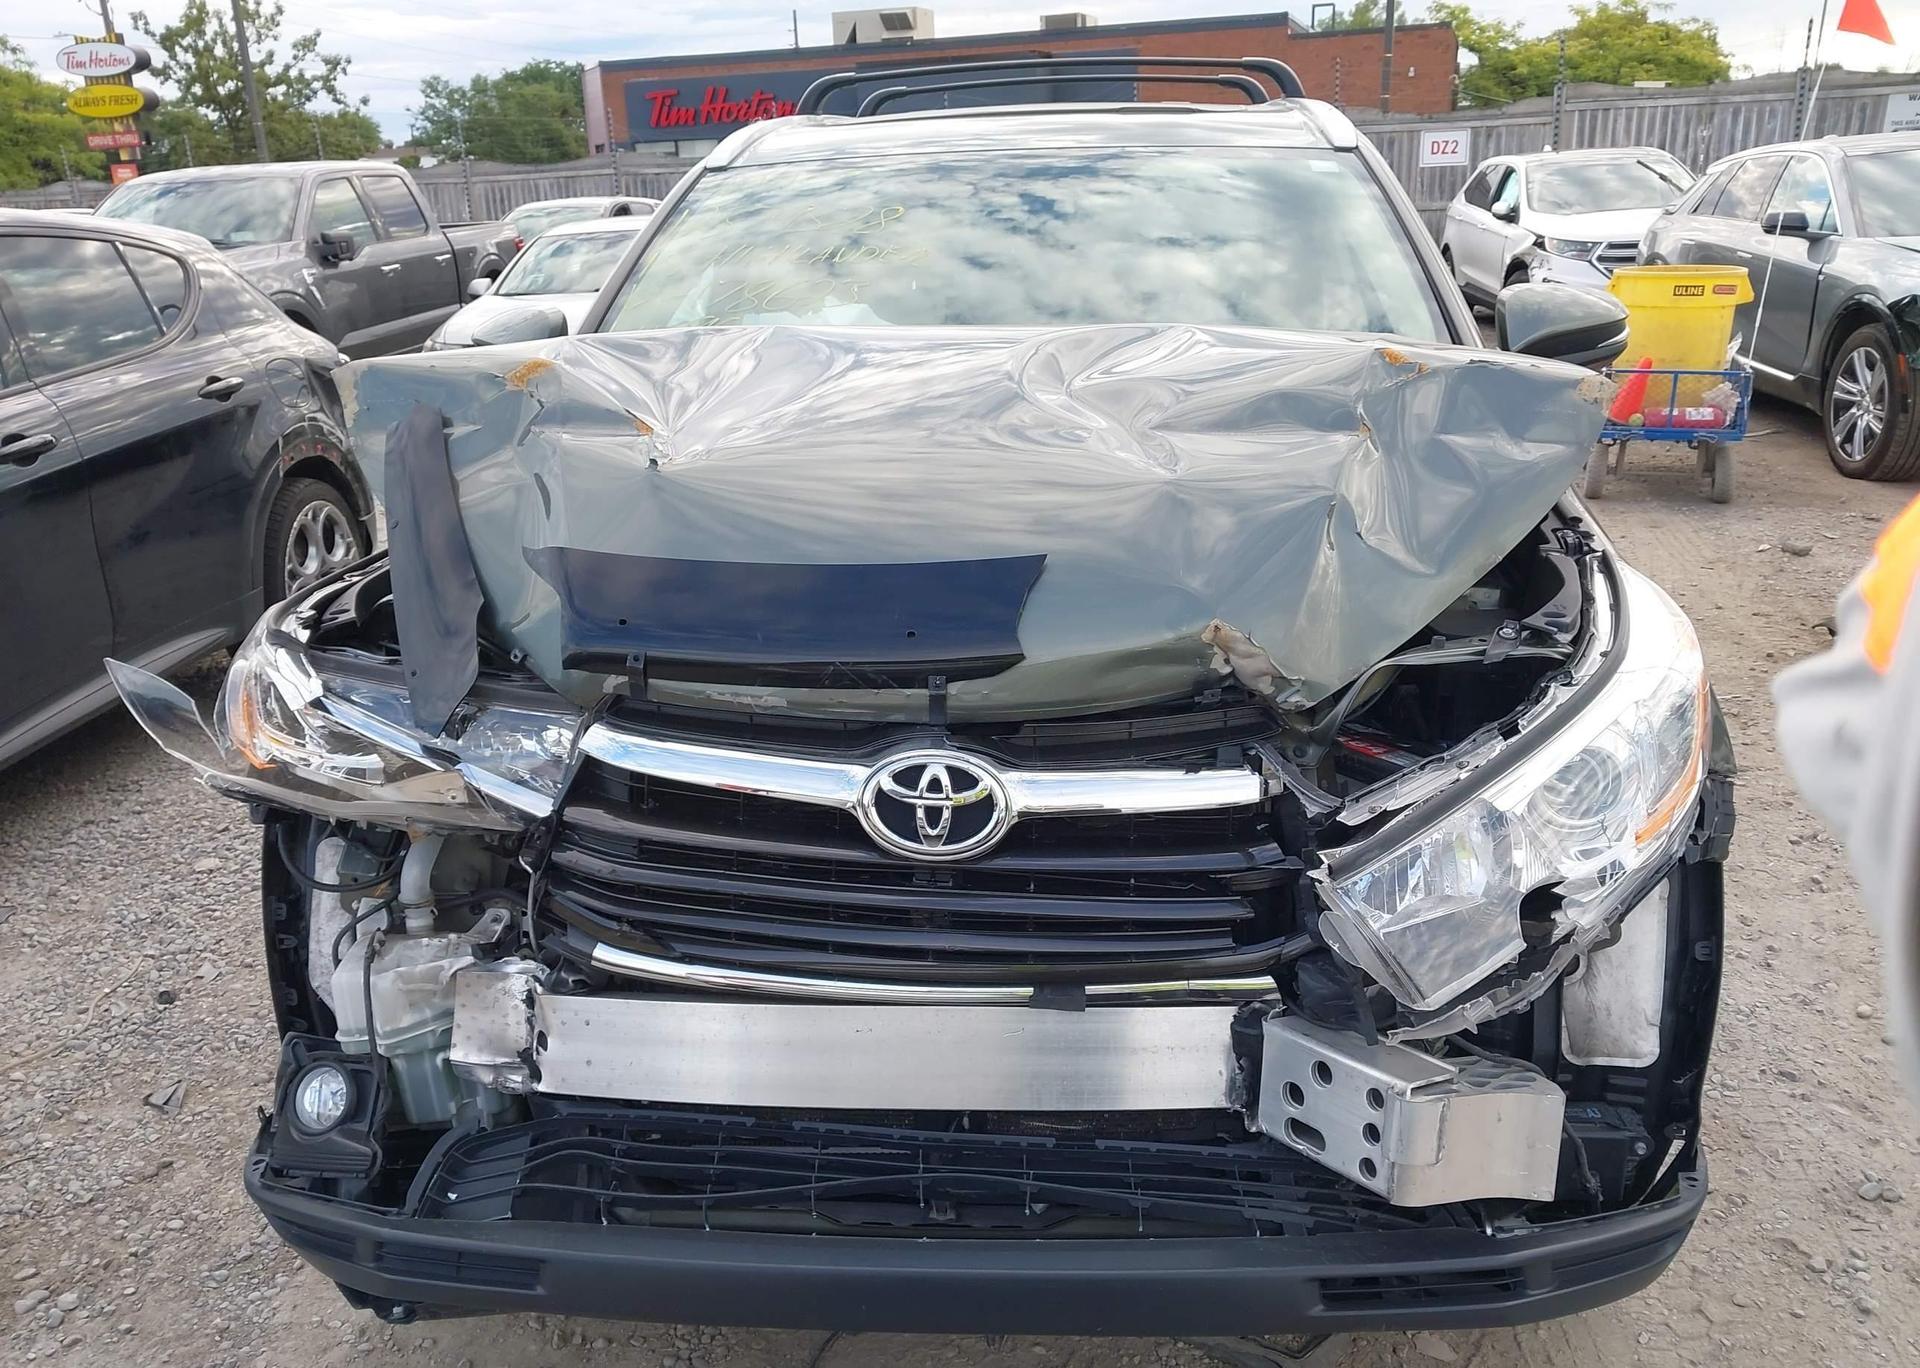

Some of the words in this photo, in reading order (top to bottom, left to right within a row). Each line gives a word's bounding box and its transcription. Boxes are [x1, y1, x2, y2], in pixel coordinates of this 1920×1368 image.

[62, 51, 87, 70] Tim
[88, 49, 131, 69] Hortons
[72, 96, 106, 107] ALWAYS
[108, 94, 138, 106] FRESH
[645, 89, 696, 128] Tim
[700, 86, 796, 124] Horton
[87, 135, 114, 146] DRIVE
[115, 134, 139, 145] THRU
[1431, 140, 1459, 155] DZ2
[1675, 286, 1704, 295] ULINE
